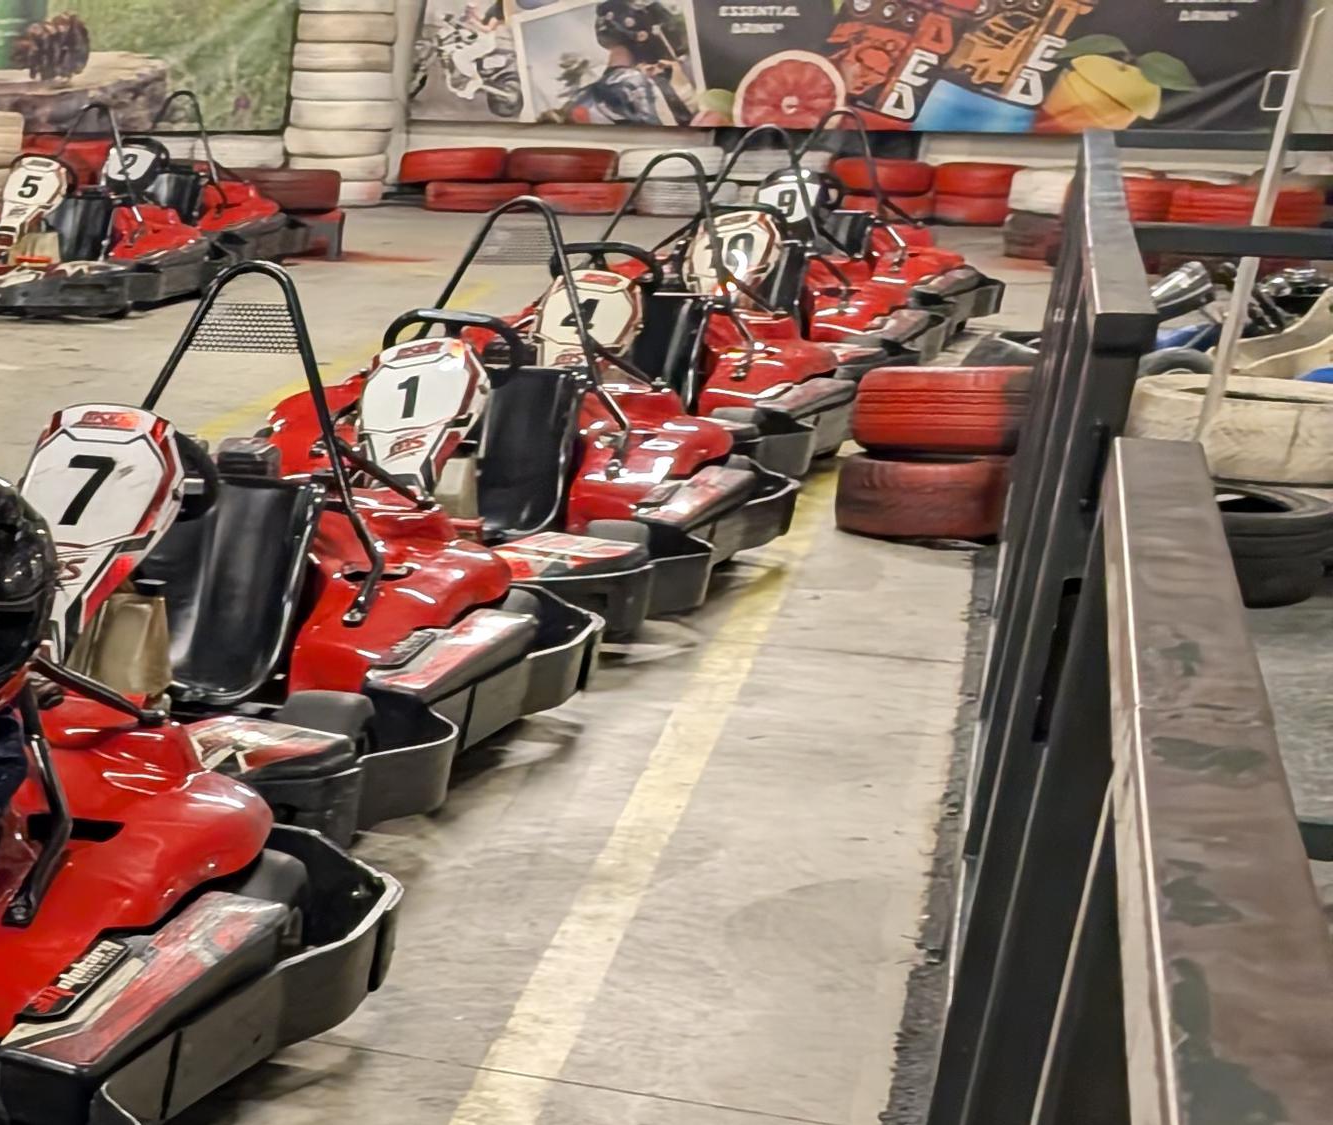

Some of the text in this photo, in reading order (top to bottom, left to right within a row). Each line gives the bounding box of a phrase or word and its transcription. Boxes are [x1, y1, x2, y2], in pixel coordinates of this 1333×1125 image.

[118, 153, 139, 175] 2
[17, 175, 44, 199] 5
[778, 189, 797, 218] 9
[559, 298, 599, 334] 4
[398, 375, 421, 419] 1
[58, 454, 117, 525] 7
